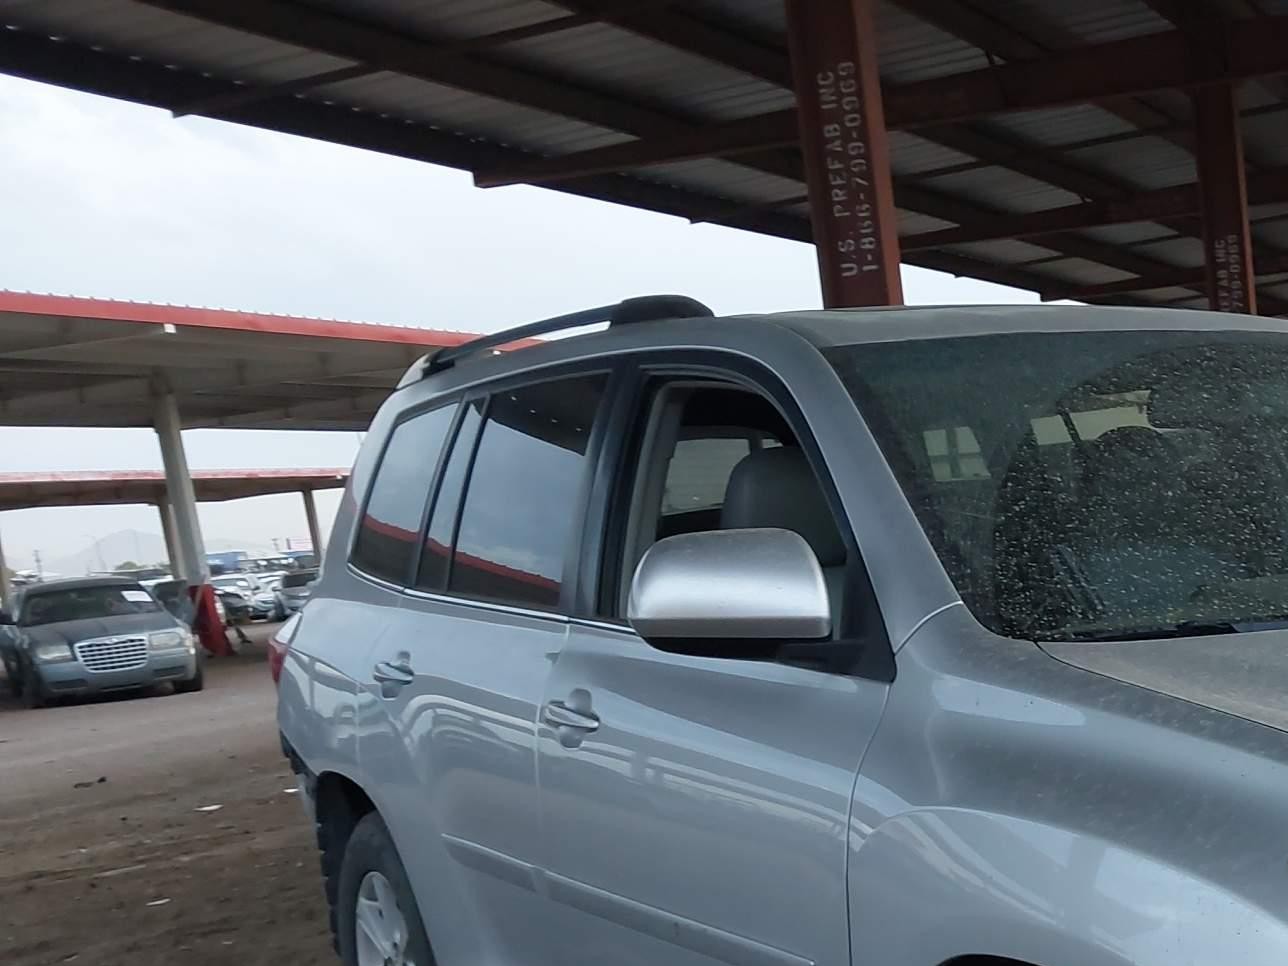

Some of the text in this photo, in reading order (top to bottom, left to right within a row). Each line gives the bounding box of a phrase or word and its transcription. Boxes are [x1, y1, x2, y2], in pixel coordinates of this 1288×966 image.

[817, 70, 858, 277] U.S. PREFAB INC
